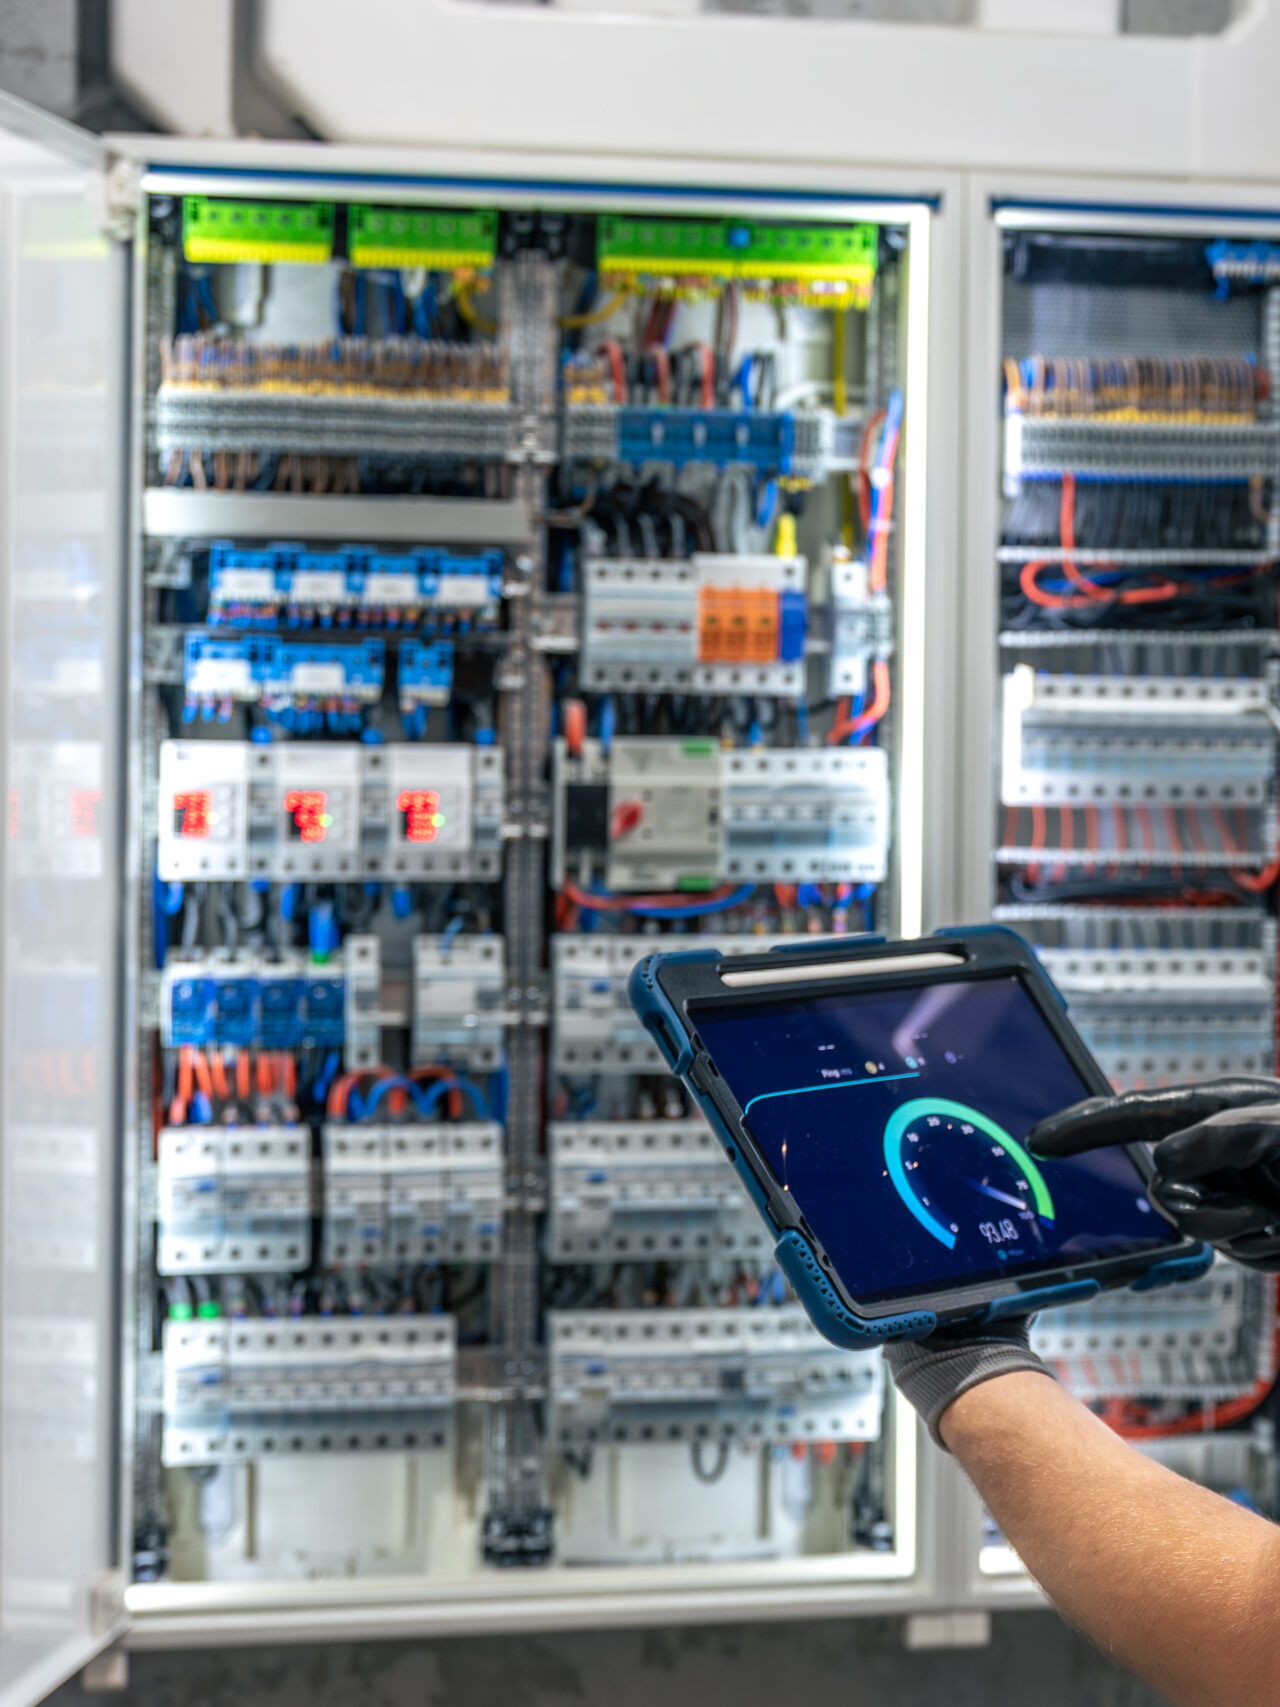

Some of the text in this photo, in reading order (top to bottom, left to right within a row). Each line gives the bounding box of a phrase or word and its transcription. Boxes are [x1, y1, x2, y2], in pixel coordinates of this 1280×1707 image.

[906, 1132, 919, 1143] 10
[1015, 1179, 1029, 1191] 75
[949, 1222, 960, 1233] 0
[978, 1218, 1019, 1244] 93.48
